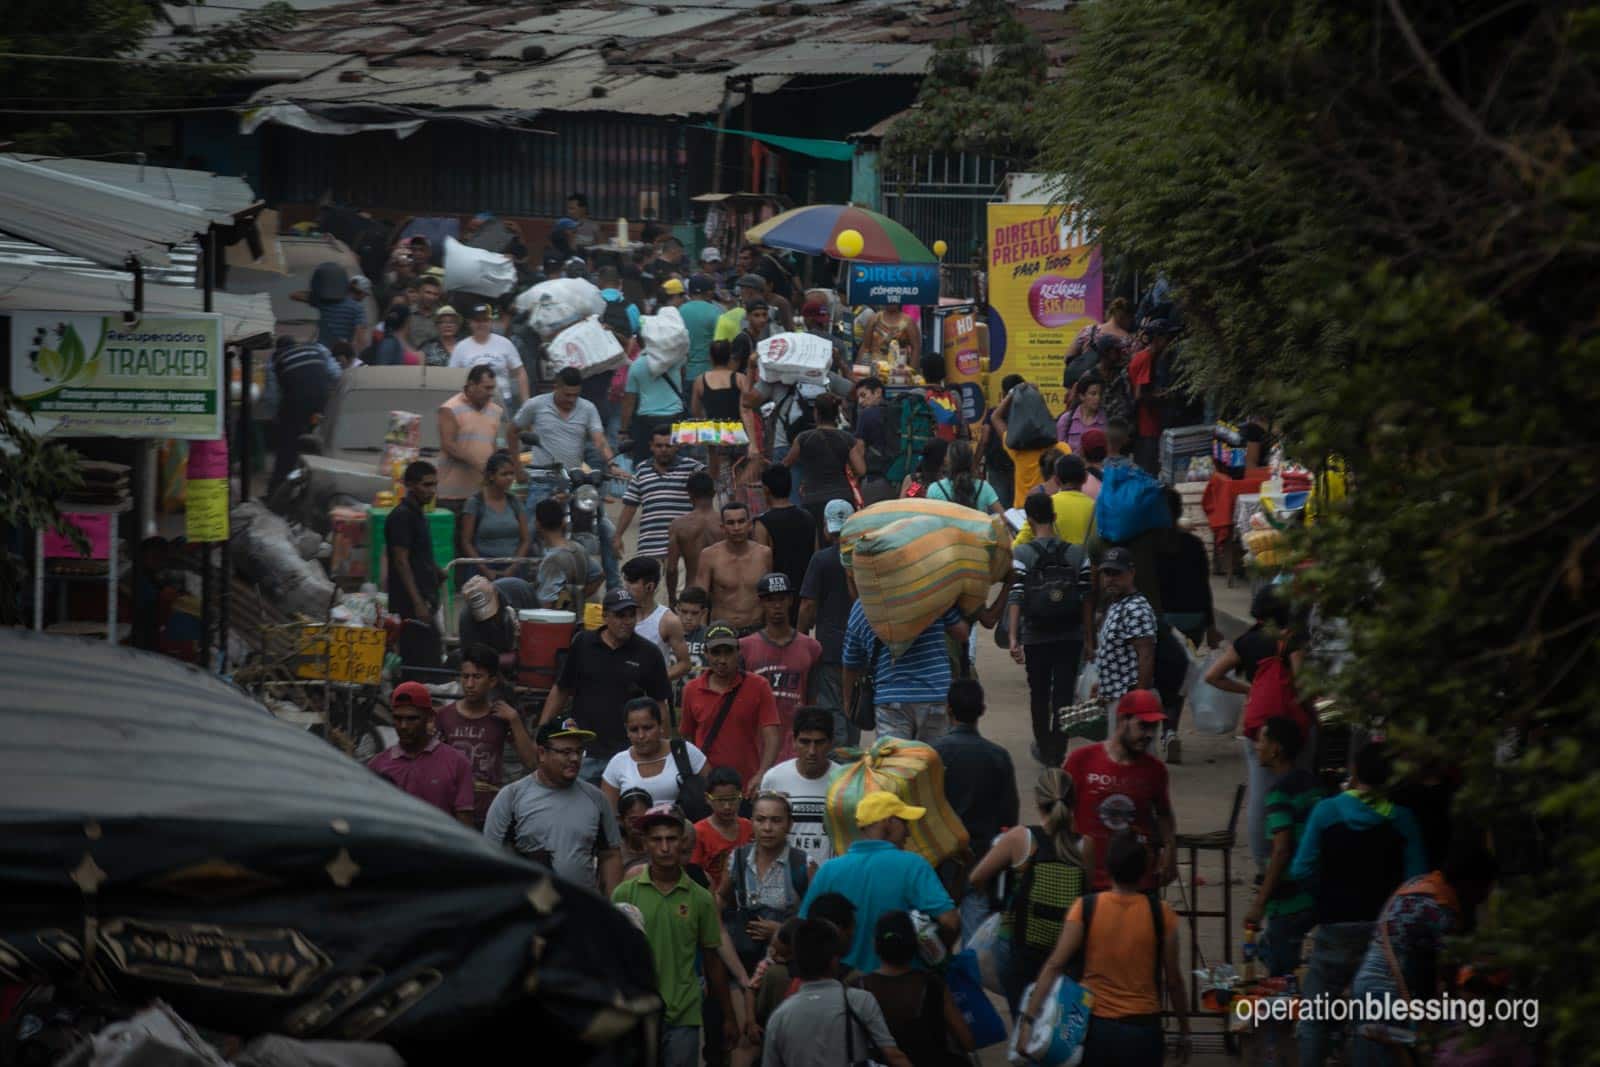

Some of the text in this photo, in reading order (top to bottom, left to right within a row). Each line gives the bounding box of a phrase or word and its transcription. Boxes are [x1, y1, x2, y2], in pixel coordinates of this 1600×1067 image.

[995, 215, 1058, 246] DIRECTV
[992, 235, 1060, 267] PREPAGO
[855, 265, 934, 284] DIRECTV
[956, 315, 974, 336] HD
[107, 330, 206, 344] Recuperadora
[106, 347, 208, 376] TRACKER
[795, 837, 823, 849] NEW
